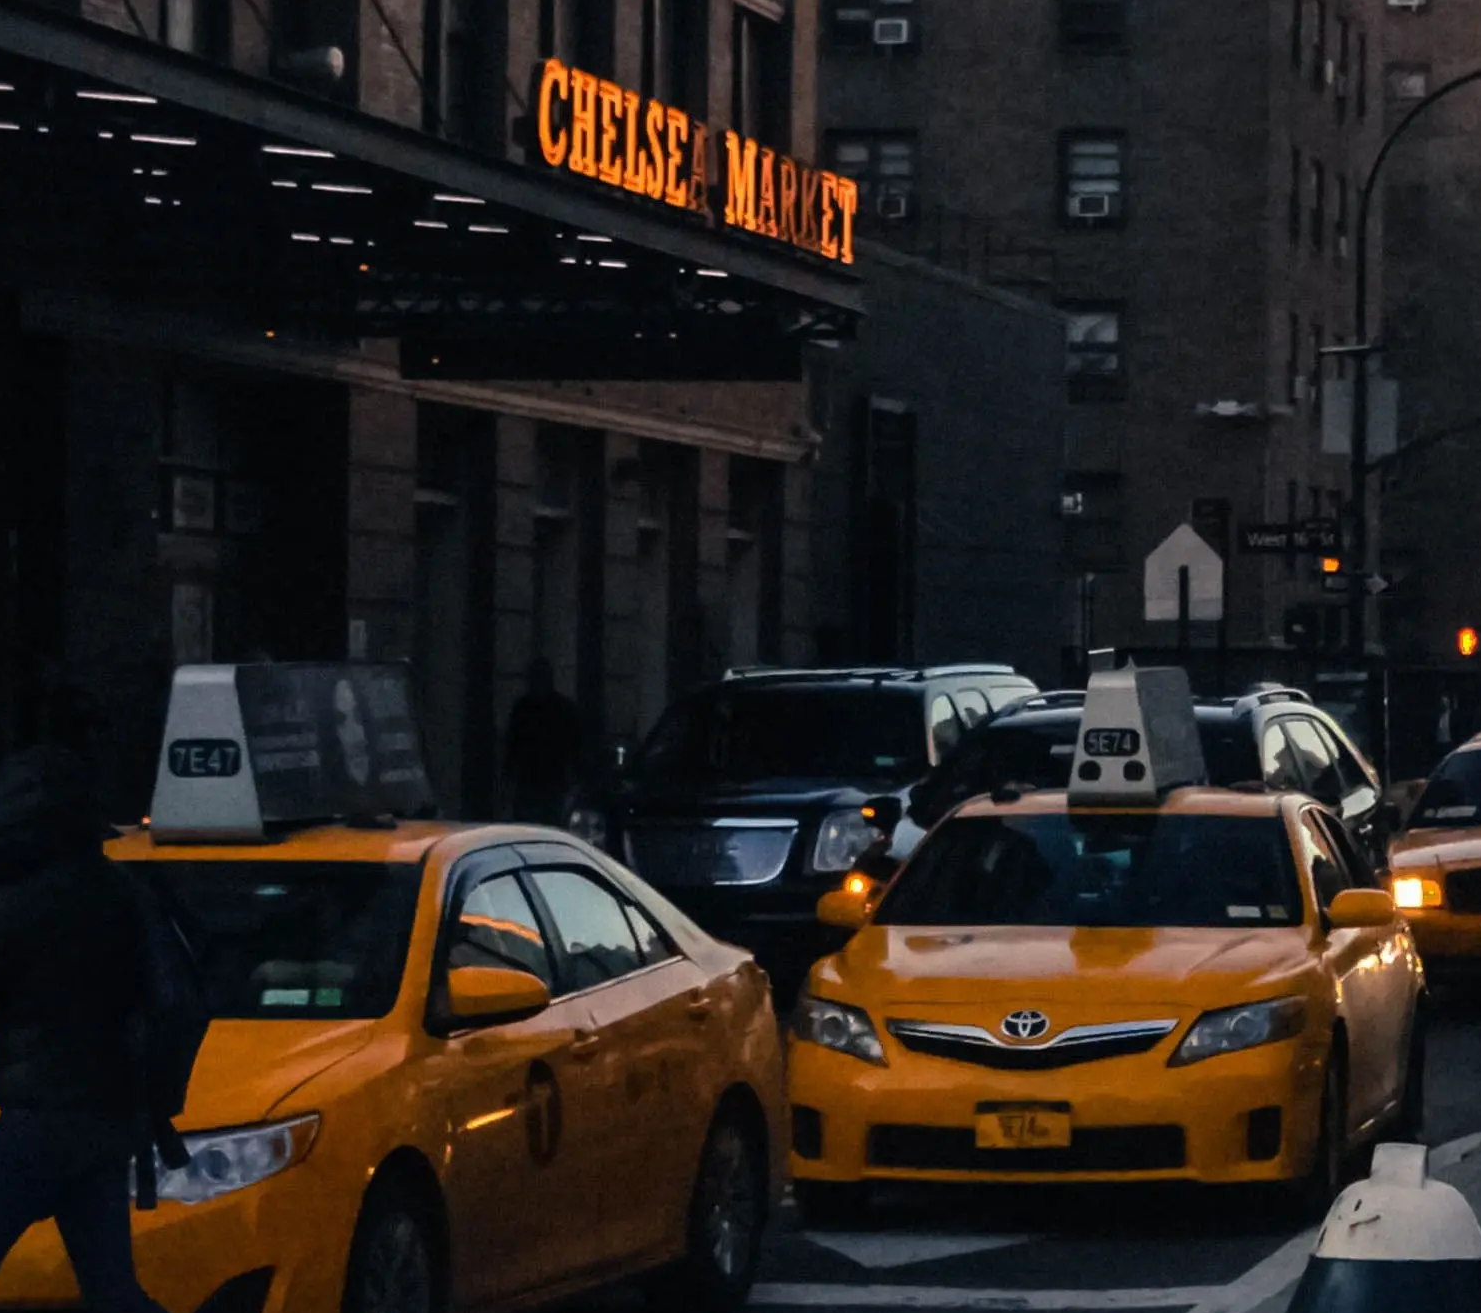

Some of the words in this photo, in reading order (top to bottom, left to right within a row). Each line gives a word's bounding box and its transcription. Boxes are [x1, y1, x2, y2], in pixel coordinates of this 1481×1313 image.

[537, 57, 713, 217] CHELSEA
[724, 128, 858, 265] MARKET
[1087, 731, 1133, 753] 5E74
[173, 746, 237, 774] 7E47
